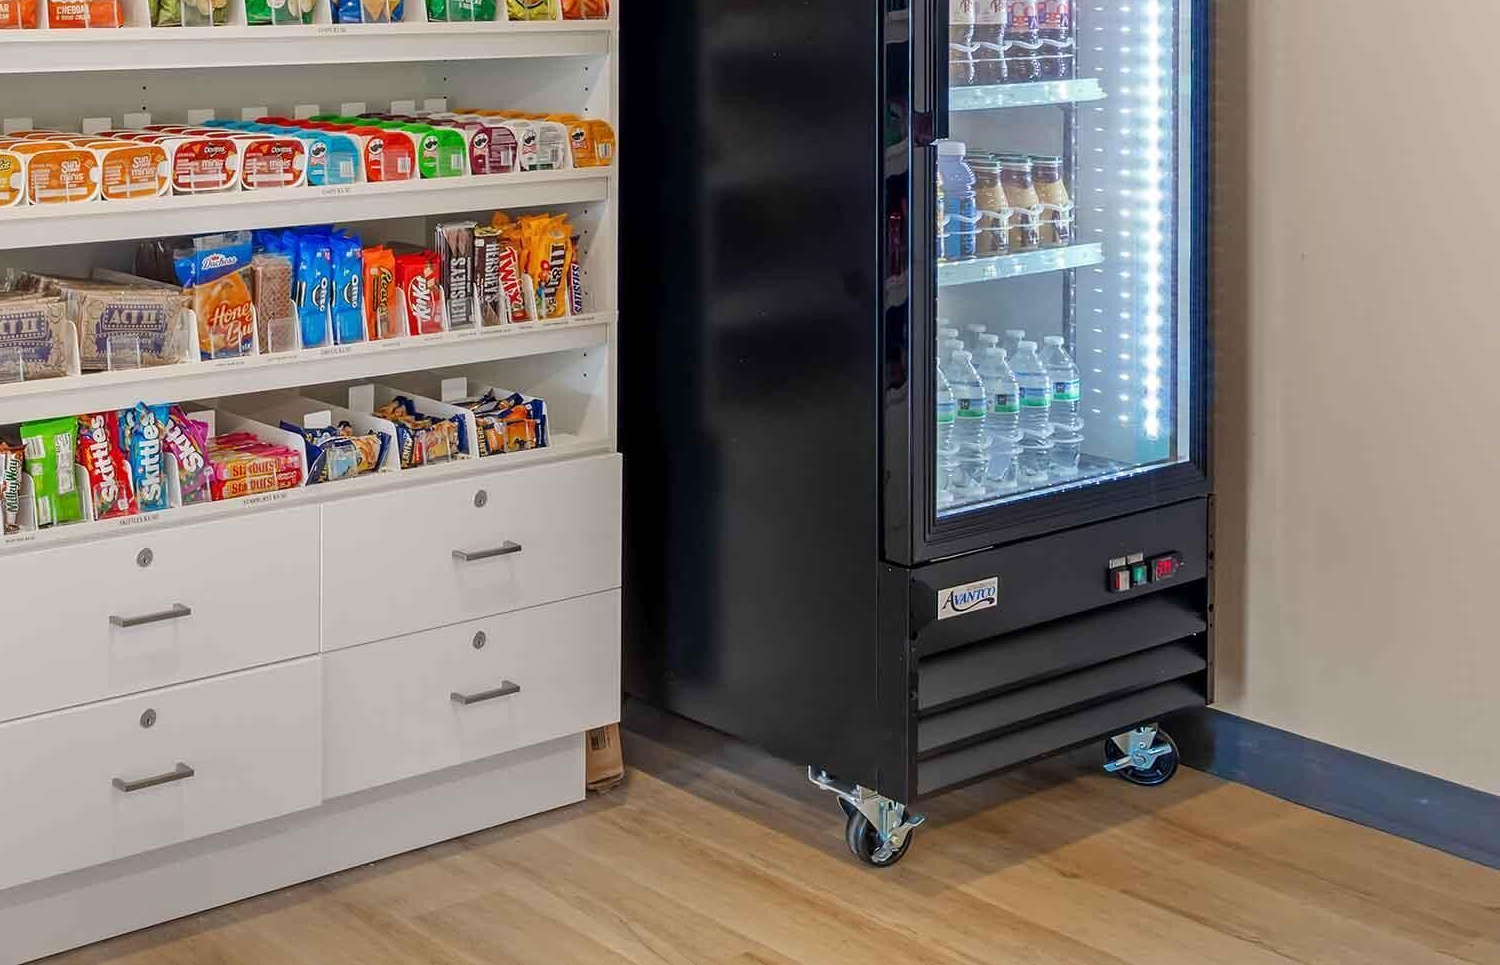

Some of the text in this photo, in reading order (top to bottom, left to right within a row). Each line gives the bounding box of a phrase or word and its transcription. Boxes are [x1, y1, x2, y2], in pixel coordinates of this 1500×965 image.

[60, 160, 80, 174] Sun
[132, 156, 149, 168] Sun
[132, 168, 156, 177] minis
[60, 173, 84, 182] minis
[484, 243, 500, 303] HERSHEY'S
[320, 277, 328, 312] OREO
[351, 274, 359, 308] OREO
[450, 257, 467, 324] HERSHEY'S
[571, 264, 582, 313] SATISFIES
[24, 317, 39, 333] II
[108, 309, 159, 324] ACT II
[92, 415, 118, 502] Skittles
[942, 586, 996, 611] AVANTCO
